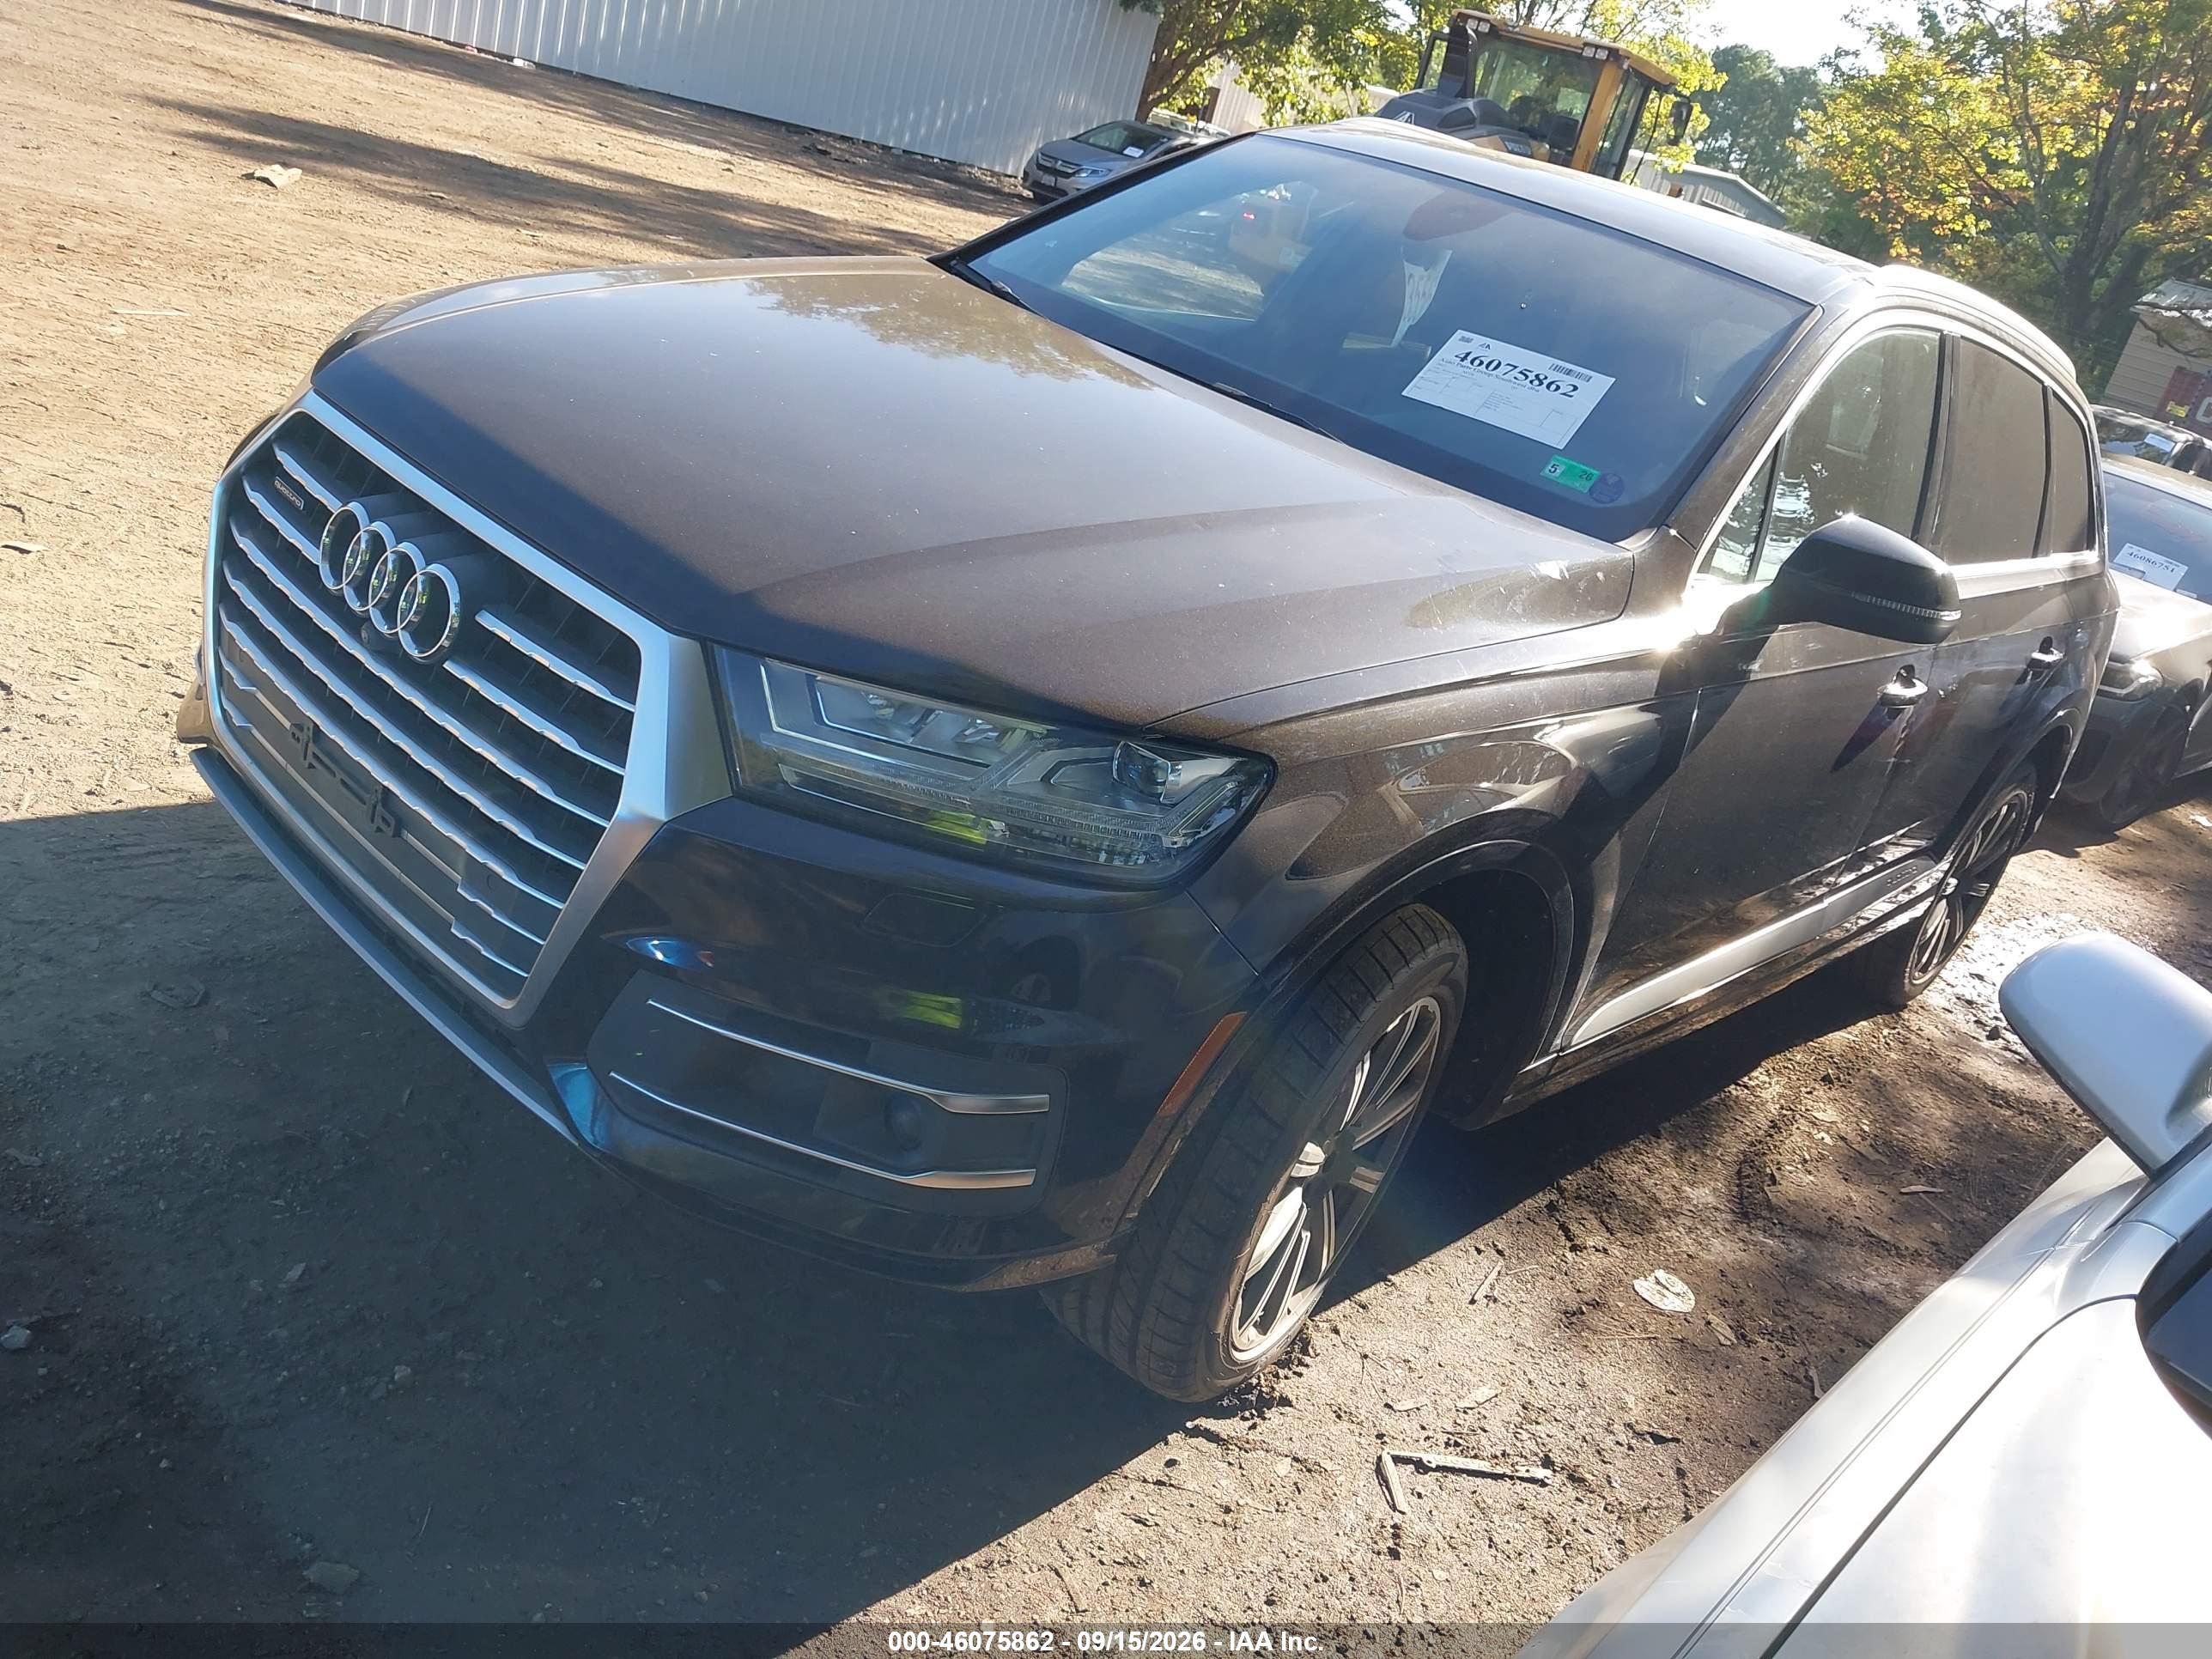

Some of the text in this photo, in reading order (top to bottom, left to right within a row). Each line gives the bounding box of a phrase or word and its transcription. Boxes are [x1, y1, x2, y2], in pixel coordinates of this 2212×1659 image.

[1454, 350, 1580, 398] 46075862
[1548, 464, 1559, 474] 5
[274, 480, 301, 507] quattro
